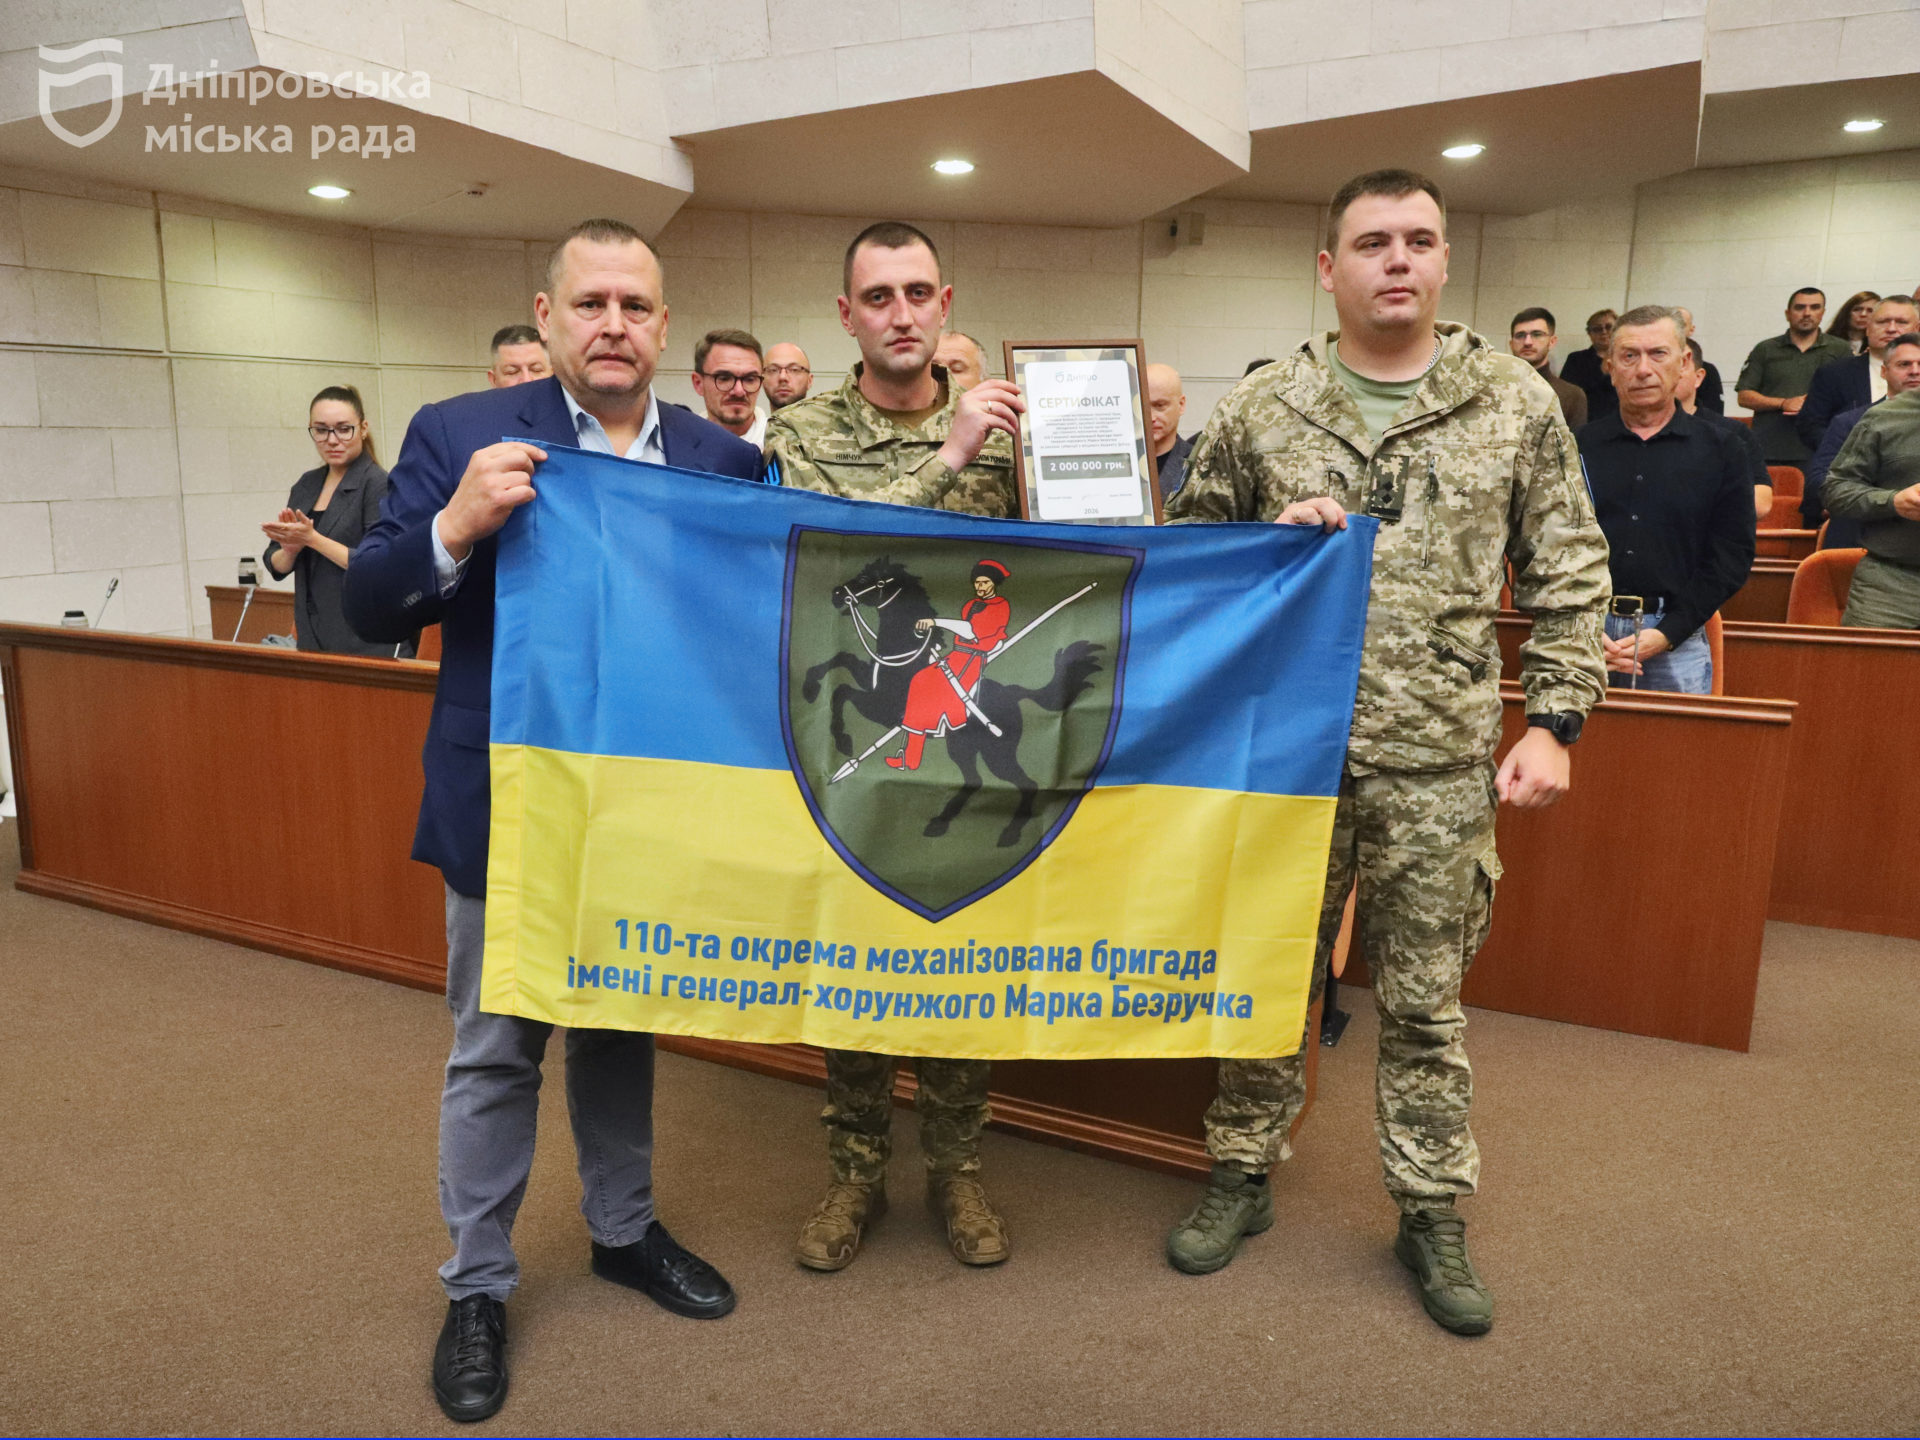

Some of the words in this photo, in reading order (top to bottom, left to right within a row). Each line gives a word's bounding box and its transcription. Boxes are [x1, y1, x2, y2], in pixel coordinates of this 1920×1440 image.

[1038, 396, 1121, 409] СЕРТИФІКАТ
[1050, 463, 1056, 472] 2
[1060, 462, 1079, 471] 000
[1082, 461, 1101, 470] 000
[1105, 461, 1125, 471] грн.
[615, 919, 720, 959] 110-та
[730, 936, 856, 970] окрема
[865, 939, 1082, 975] механізована
[1091, 939, 1217, 980] бригада
[567, 956, 652, 994] імені
[661, 973, 996, 1021] генерал-хорунжого
[1004, 984, 1102, 1025] Марка
[1111, 985, 1254, 1023] Безручка
